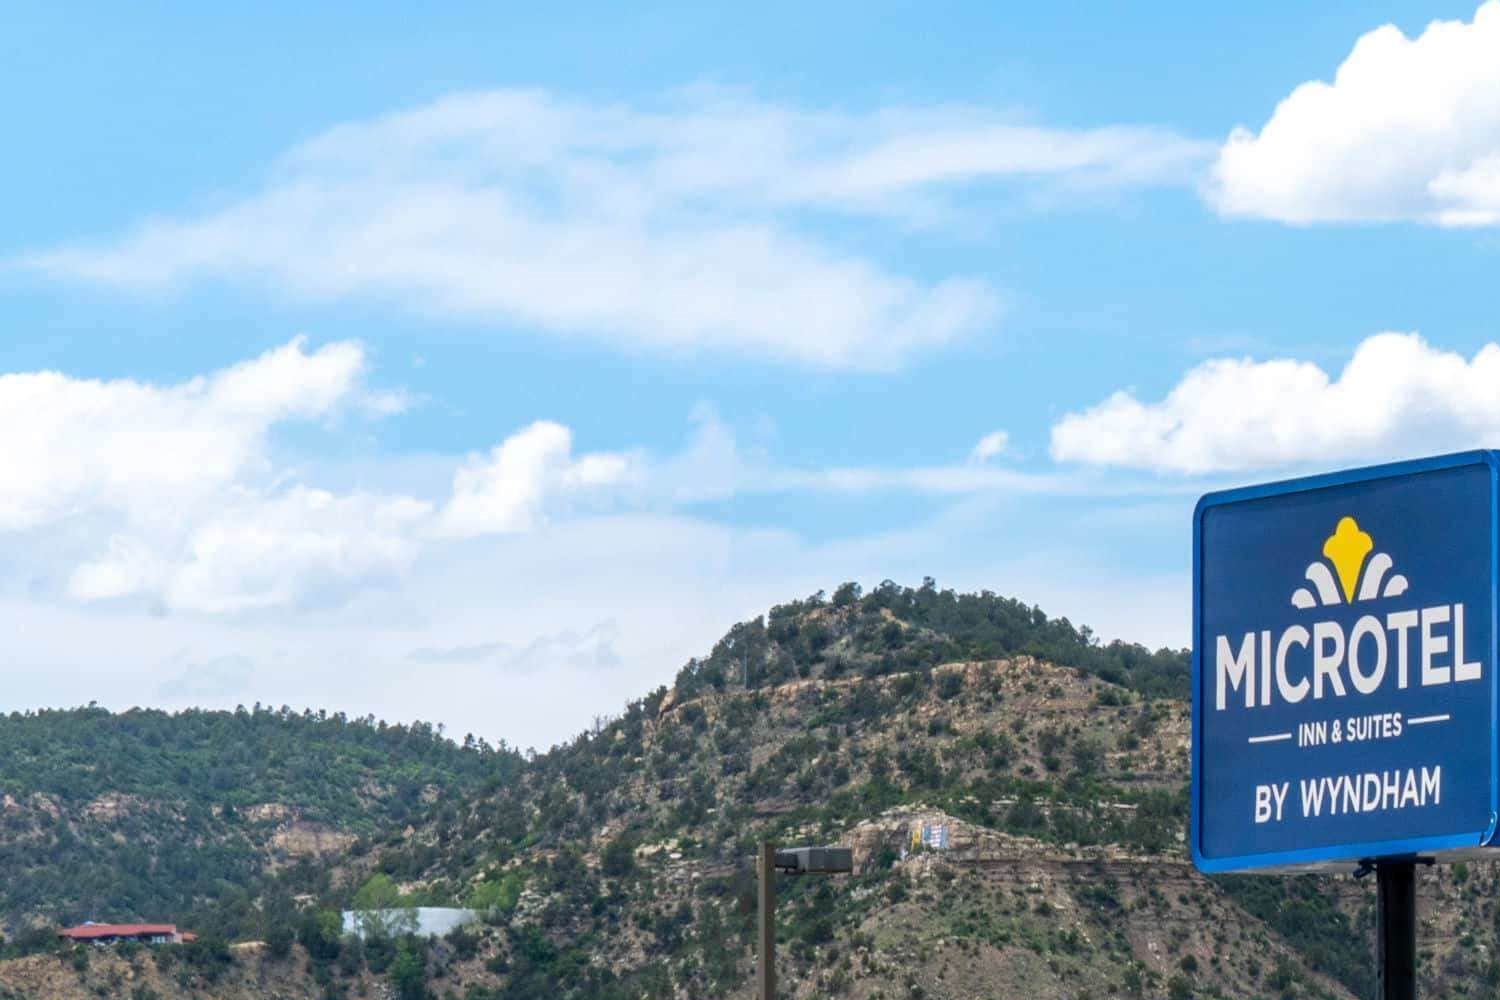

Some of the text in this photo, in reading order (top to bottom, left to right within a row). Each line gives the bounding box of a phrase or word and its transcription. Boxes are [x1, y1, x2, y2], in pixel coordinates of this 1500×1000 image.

[1215, 603, 1482, 711] MICROTEL
[1298, 713, 1403, 747] INN & SUITES
[1254, 766, 1441, 824] BY WYNDHAM
